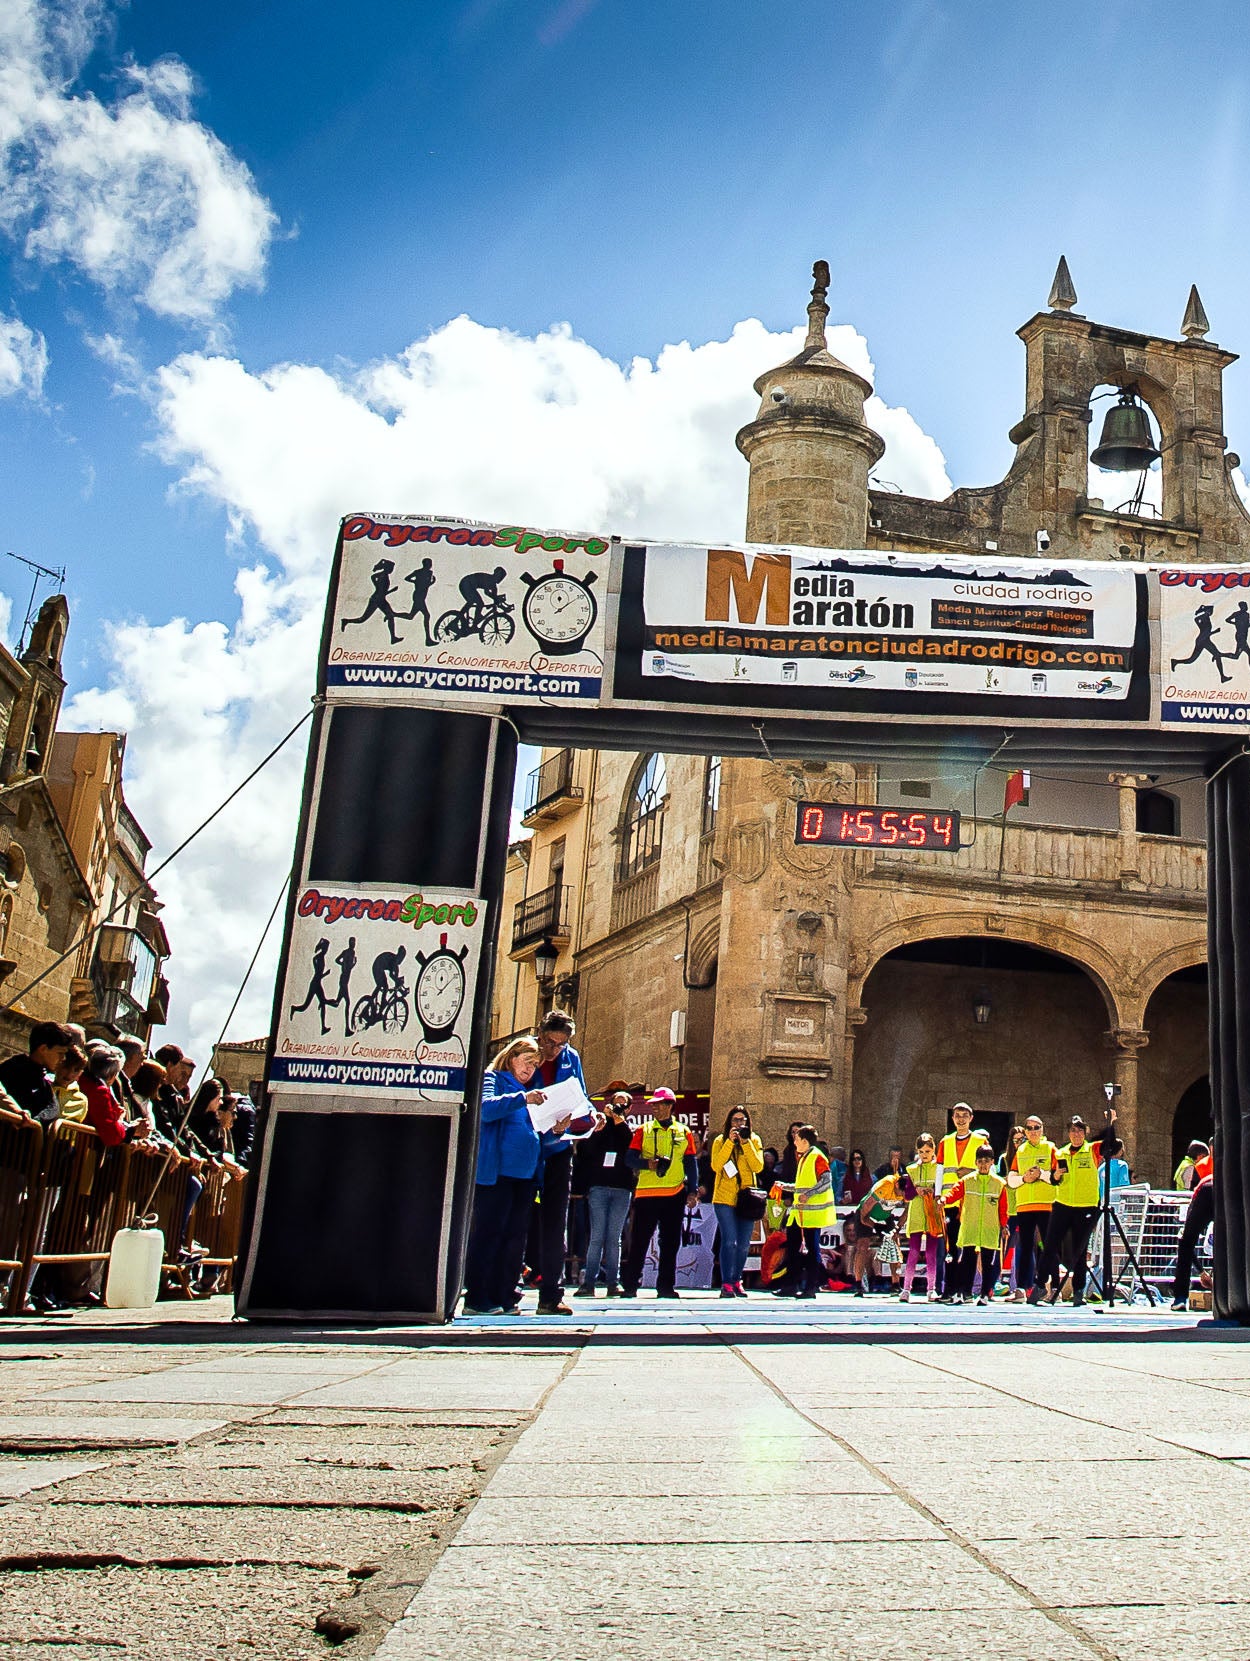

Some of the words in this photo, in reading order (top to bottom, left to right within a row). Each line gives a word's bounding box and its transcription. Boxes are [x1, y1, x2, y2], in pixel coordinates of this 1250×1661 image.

[342, 516, 609, 555] OrycronSport
[543, 585, 553, 594] 55
[568, 585, 574, 593] 5
[953, 583, 1020, 599] ciudad
[1026, 587, 1093, 604] rodrigo
[576, 618, 585, 626] 20
[938, 604, 972, 614] Media
[1024, 610, 1043, 618] por
[1047, 610, 1087, 622] Relevos
[545, 627, 554, 635] 35
[938, 616, 970, 625] Sancti
[1051, 623, 1088, 634] Rodrigo
[655, 630, 1124, 666] mediamaratonciudadrodrigo.com
[331, 647, 419, 664] ORGANIZACIÓN
[436, 651, 531, 671] CRONOMETRAJE
[535, 657, 603, 675] DEPORTIVO
[345, 667, 580, 694] www.orycronsport.com
[1164, 685, 1248, 701] ORGANIZACIÓN
[298, 889, 477, 930] OrycronSport
[287, 1063, 448, 1086] www.orycronsport.com
[679, 1113, 698, 1126] DE
